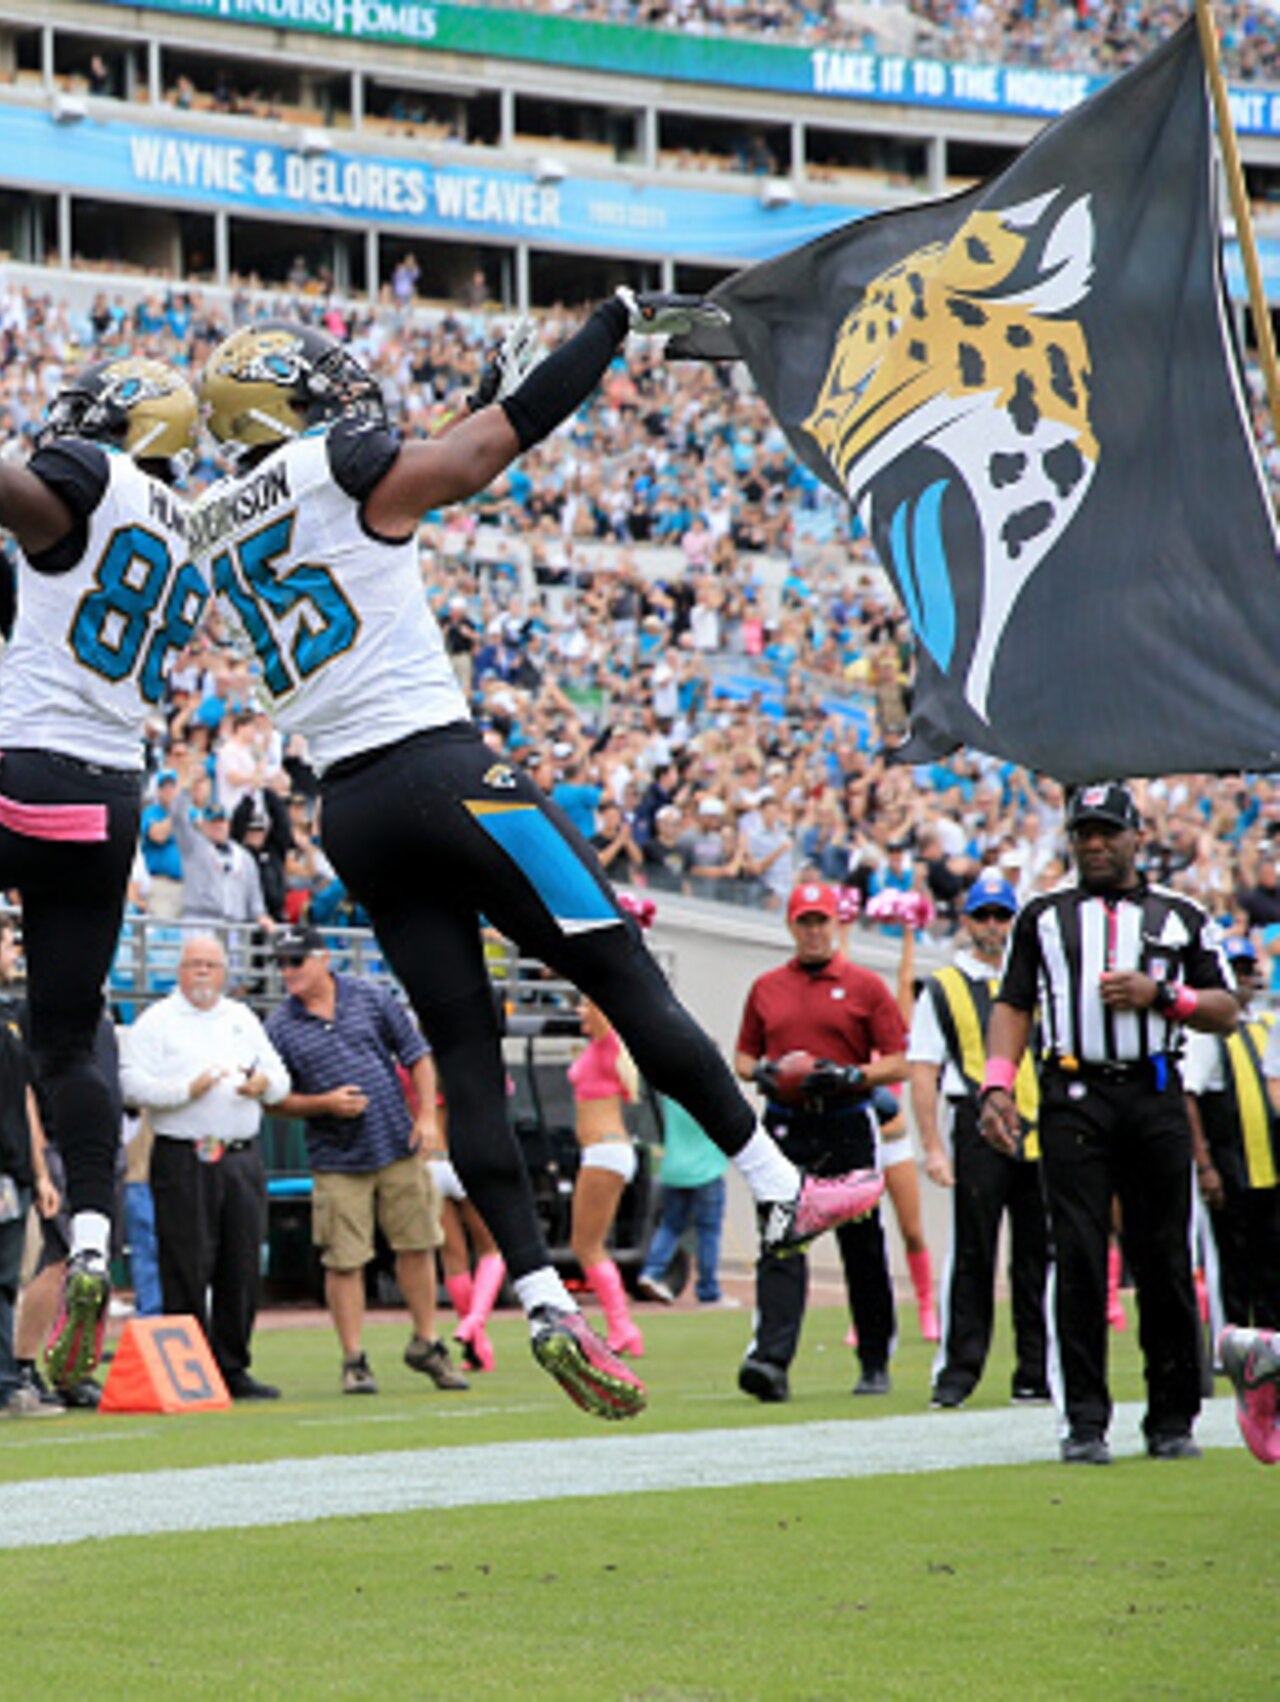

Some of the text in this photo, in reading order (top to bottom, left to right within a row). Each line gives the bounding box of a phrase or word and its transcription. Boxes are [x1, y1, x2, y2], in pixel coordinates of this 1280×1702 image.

[810, 50, 876, 93] TAKE
[878, 53, 906, 94] IT
[912, 58, 948, 98] TO
[951, 63, 999, 102] THE
[130, 136, 245, 187] WAYNE
[251, 153, 280, 196] &
[284, 156, 427, 216] DELORES
[433, 173, 561, 229] WEAVER
[67, 522, 212, 706] 88
[211, 507, 363, 701] 15
[152, 1327, 213, 1401] G
